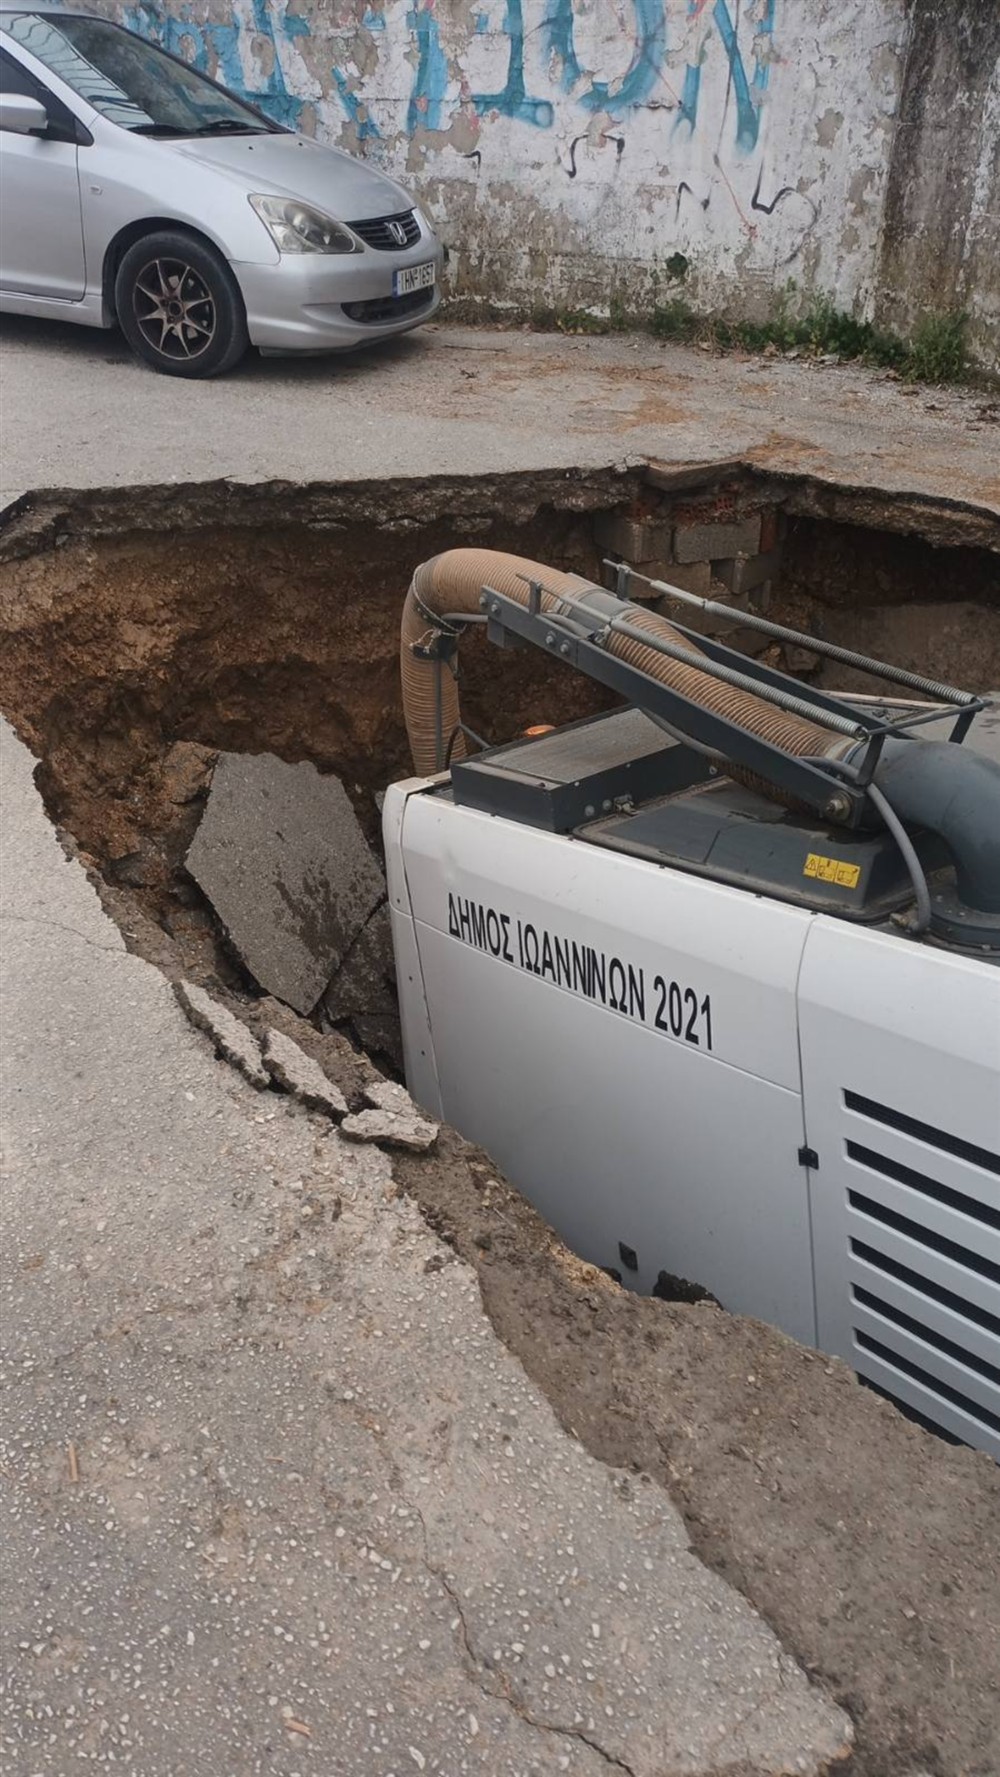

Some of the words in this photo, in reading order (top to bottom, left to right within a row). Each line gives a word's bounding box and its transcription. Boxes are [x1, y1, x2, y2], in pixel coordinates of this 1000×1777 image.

[449, 892, 514, 963] ΔΗΜΟΣ
[517, 920, 645, 1021] ΙΩΑΝΝΙΝΩΝ
[653, 975, 712, 1050] 2021
